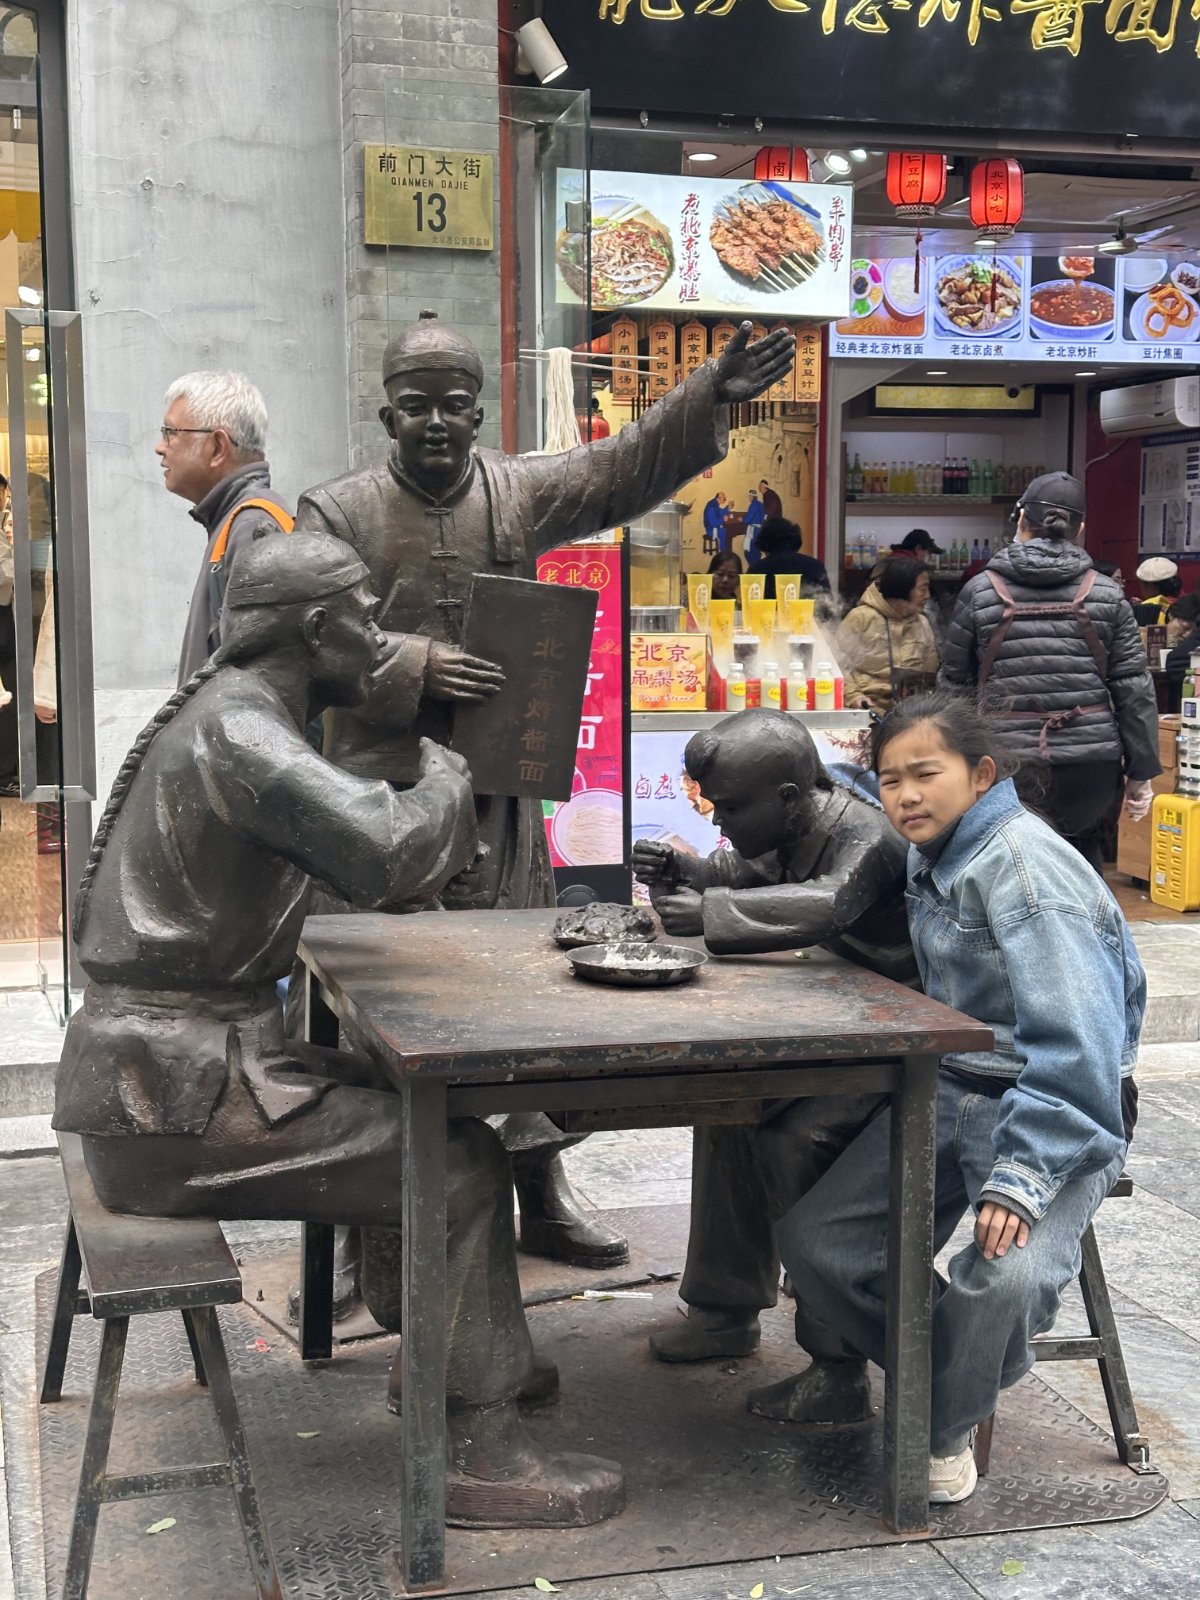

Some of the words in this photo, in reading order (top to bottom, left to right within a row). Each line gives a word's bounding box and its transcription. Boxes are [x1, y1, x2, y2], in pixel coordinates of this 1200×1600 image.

[378, 153, 481, 179] 前门大街
[391, 176, 434, 188] QIANMEN
[441, 179, 469, 190] DAJIE
[989, 170, 1004, 214] 北京小吃
[412, 191, 447, 233] 13
[828, 195, 845, 272] 羊肉串
[801, 334, 816, 389] 老北京豆汁
[543, 568, 604, 585] 老北京
[631, 643, 691, 662] 北京
[631, 669, 699, 687] 吊梨汤
[635, 771, 677, 800] 卤煮
